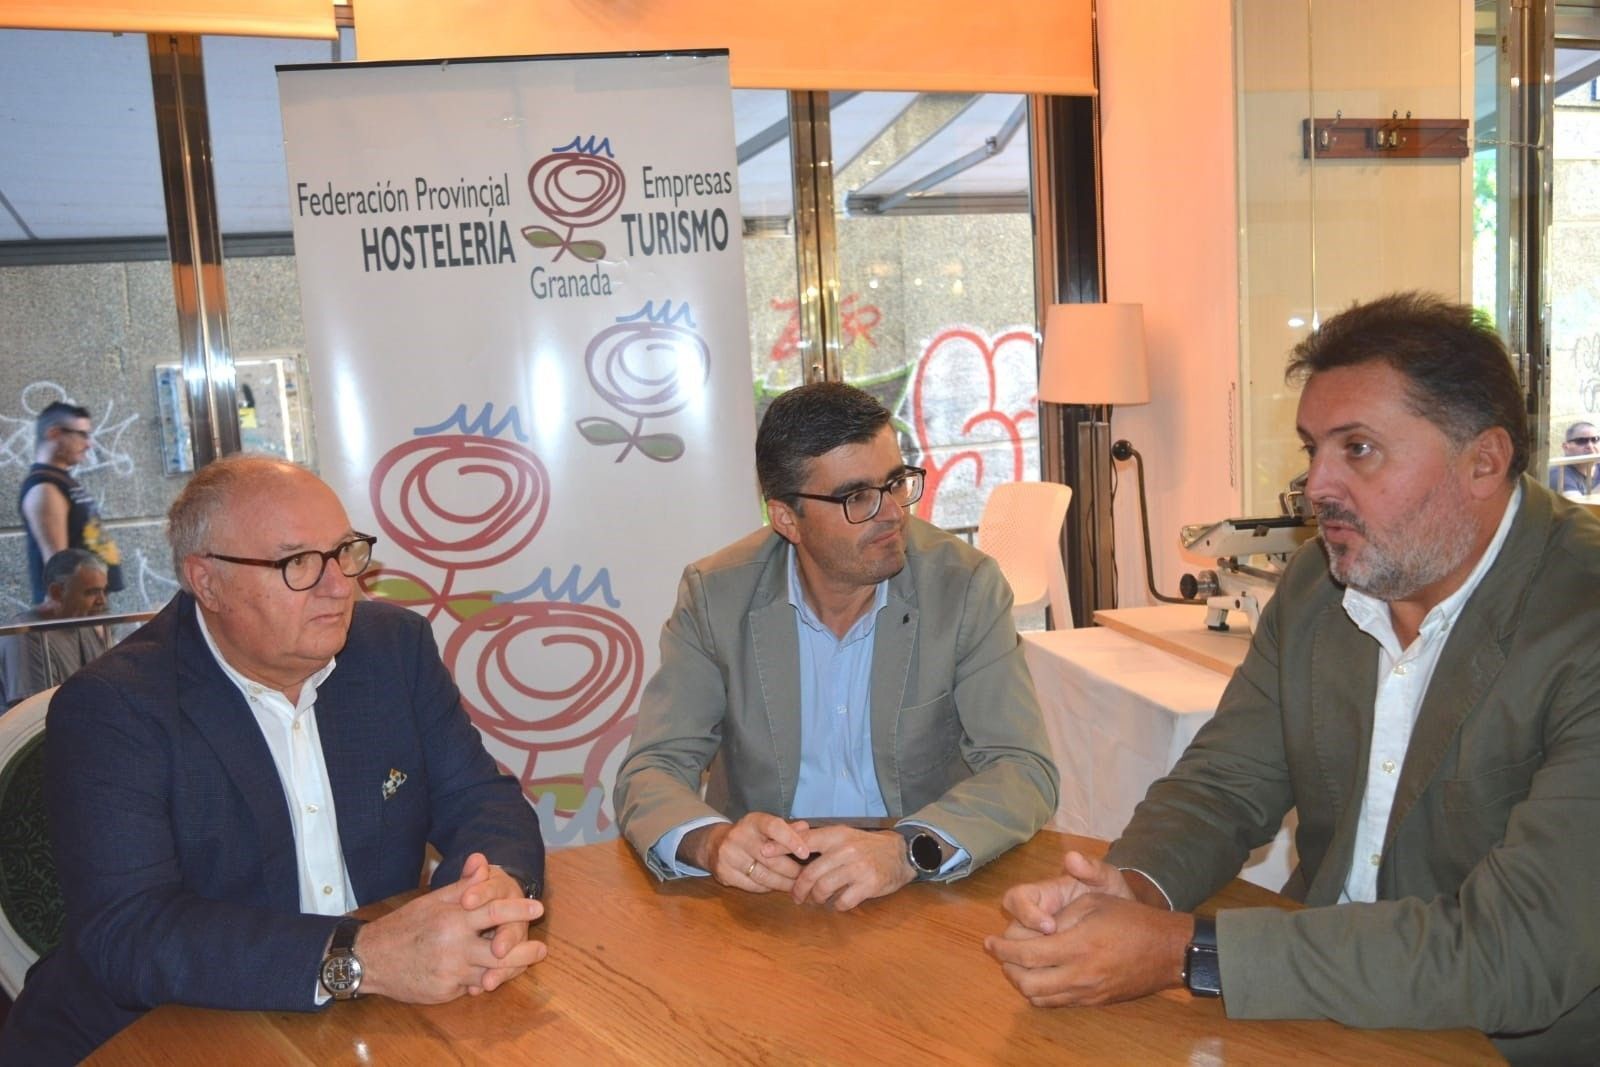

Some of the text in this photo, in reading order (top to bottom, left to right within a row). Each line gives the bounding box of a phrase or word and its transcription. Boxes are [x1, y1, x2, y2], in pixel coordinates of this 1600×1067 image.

[297, 172, 511, 217] Federación Provincial
[642, 165, 733, 208] Empresas
[360, 207, 517, 273] HOSTELERÍA
[620, 207, 730, 257] TURISMO
[530, 263, 613, 300] Granada
